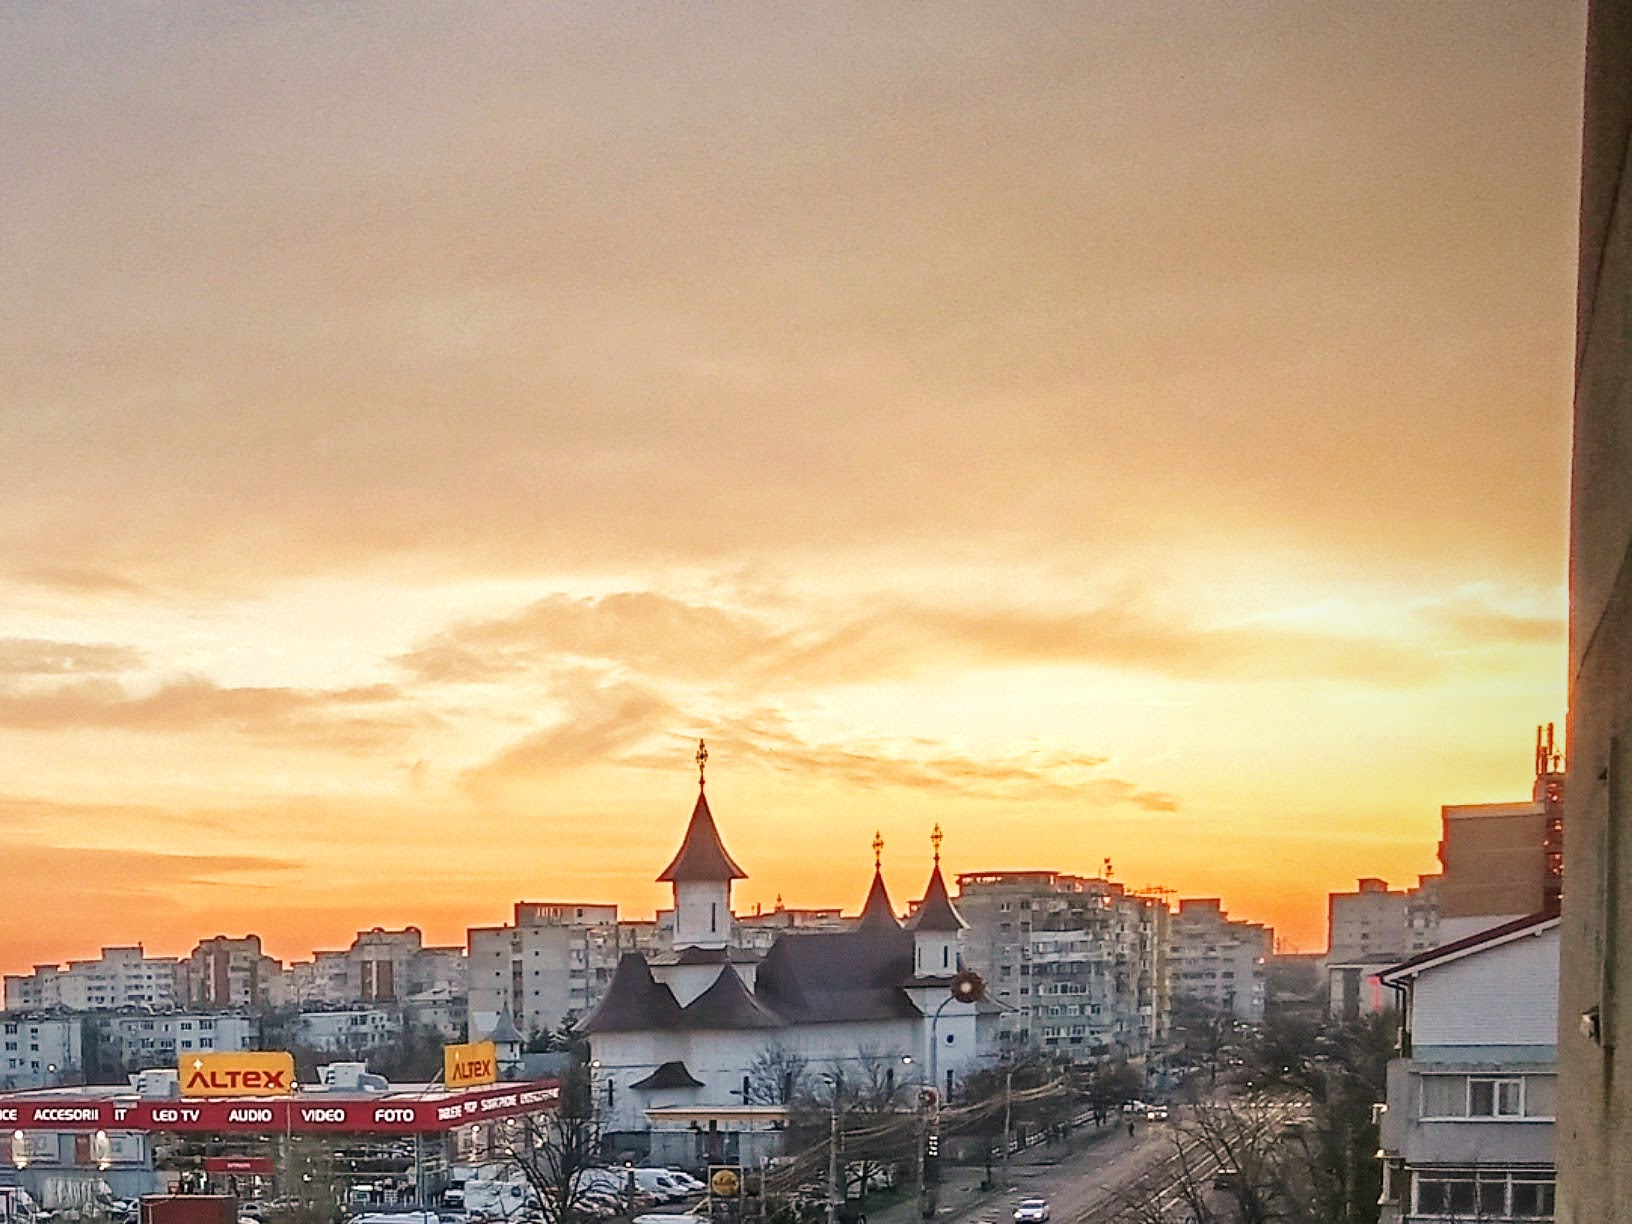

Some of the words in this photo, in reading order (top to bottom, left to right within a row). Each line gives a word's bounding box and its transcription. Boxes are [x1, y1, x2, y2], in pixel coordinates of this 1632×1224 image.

[33, 1108, 99, 1121] ACCESORII
[114, 1108, 128, 1121] IT
[152, 1109, 178, 1122] LED
[180, 1109, 200, 1122] TV
[228, 1108, 272, 1122] AUDIO
[301, 1108, 345, 1122] VIDEO
[374, 1108, 415, 1122] FOTO
